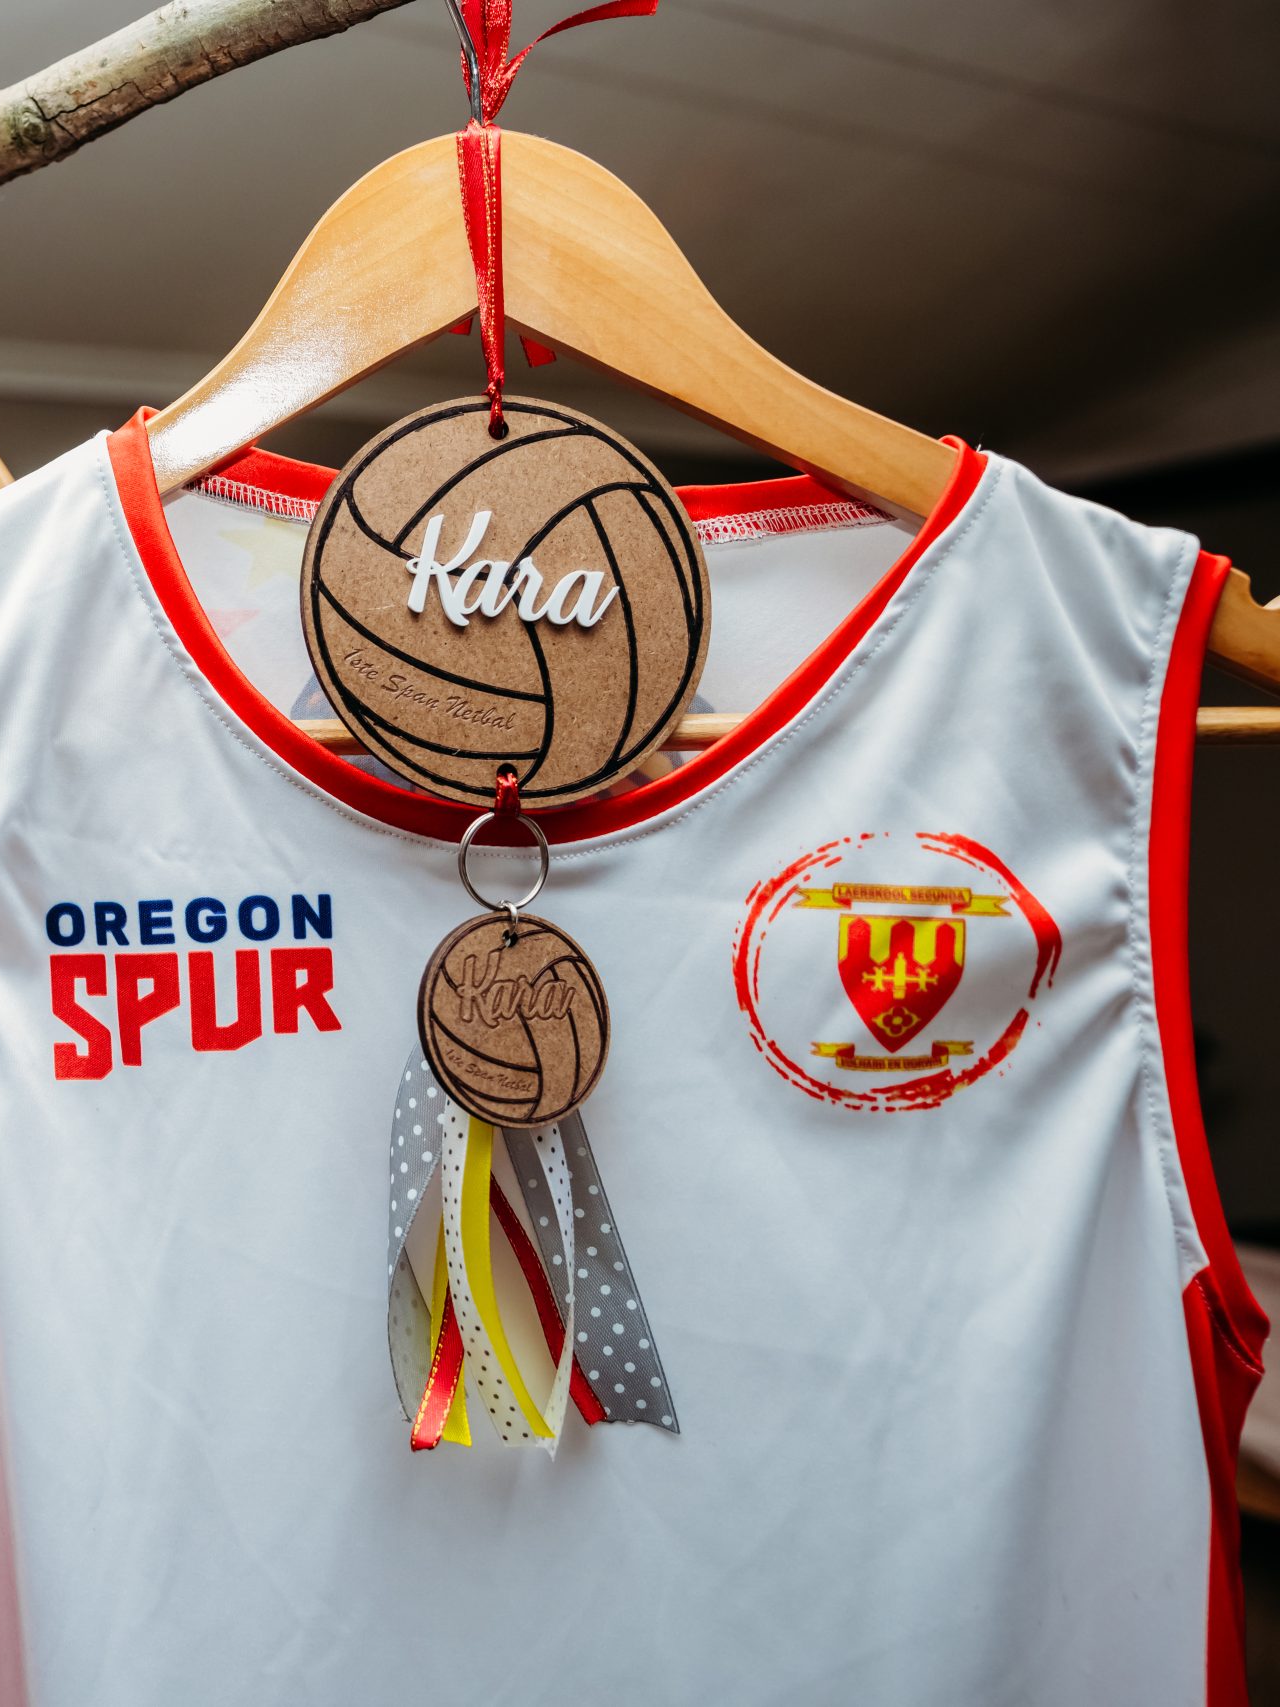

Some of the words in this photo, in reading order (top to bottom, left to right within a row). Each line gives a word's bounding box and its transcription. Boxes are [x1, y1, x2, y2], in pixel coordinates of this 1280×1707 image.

[406, 510, 620, 629] Kara
[381, 674, 440, 709] Span
[446, 695, 517, 731] Netbal
[45, 893, 333, 947] OREGON
[49, 946, 343, 1081] SPUR
[456, 948, 577, 1029] Kara
